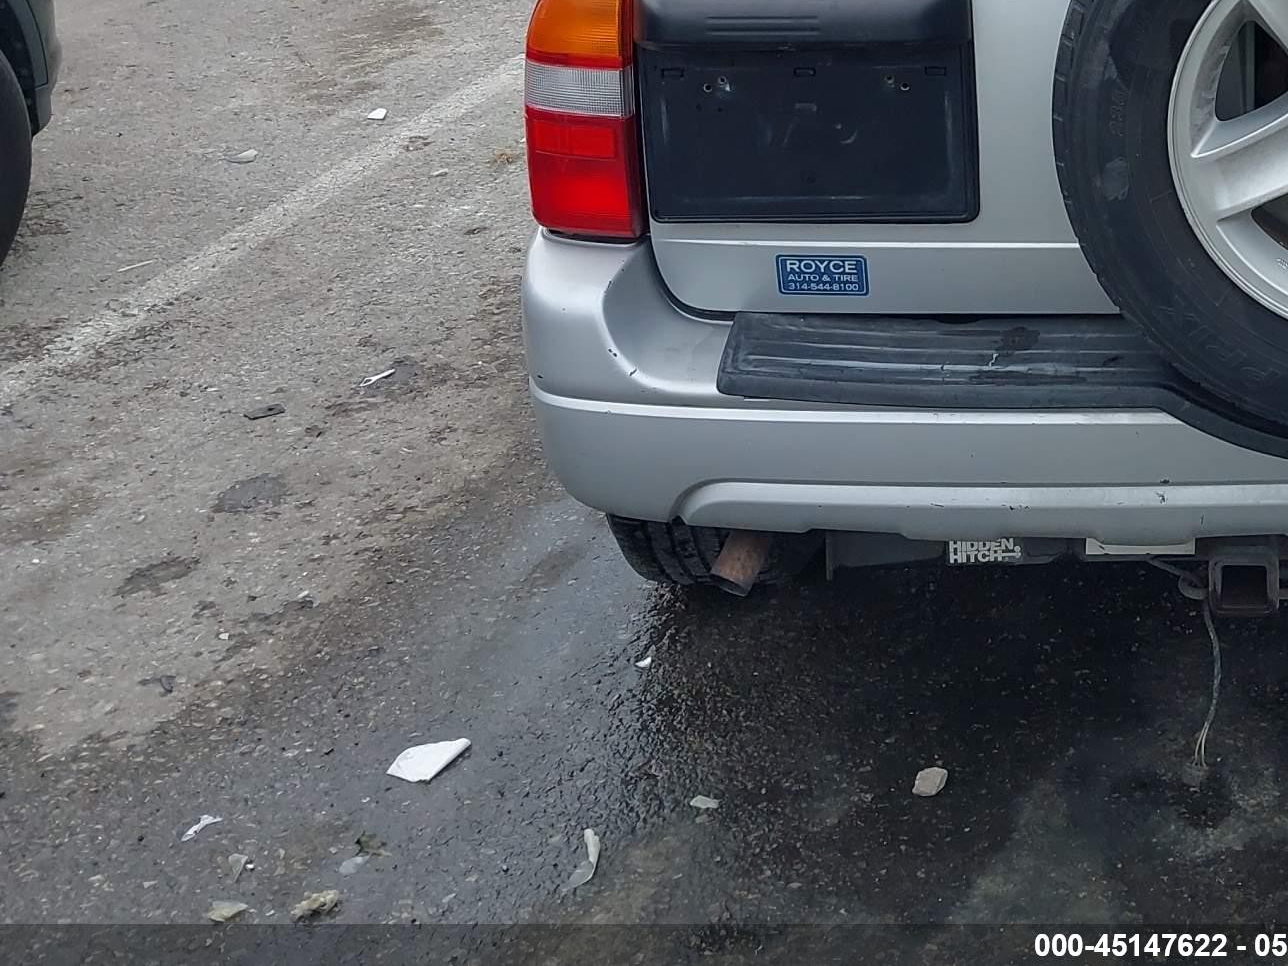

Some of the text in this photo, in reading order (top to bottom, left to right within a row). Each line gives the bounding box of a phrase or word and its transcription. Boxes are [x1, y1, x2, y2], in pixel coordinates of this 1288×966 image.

[785, 260, 858, 273] ROYCE
[787, 274, 820, 282] AUTO
[821, 274, 832, 282] &
[787, 282, 860, 291] 314-544-8100
[949, 538, 1014, 552] HIDDEN
[949, 550, 1003, 564] HITCH
